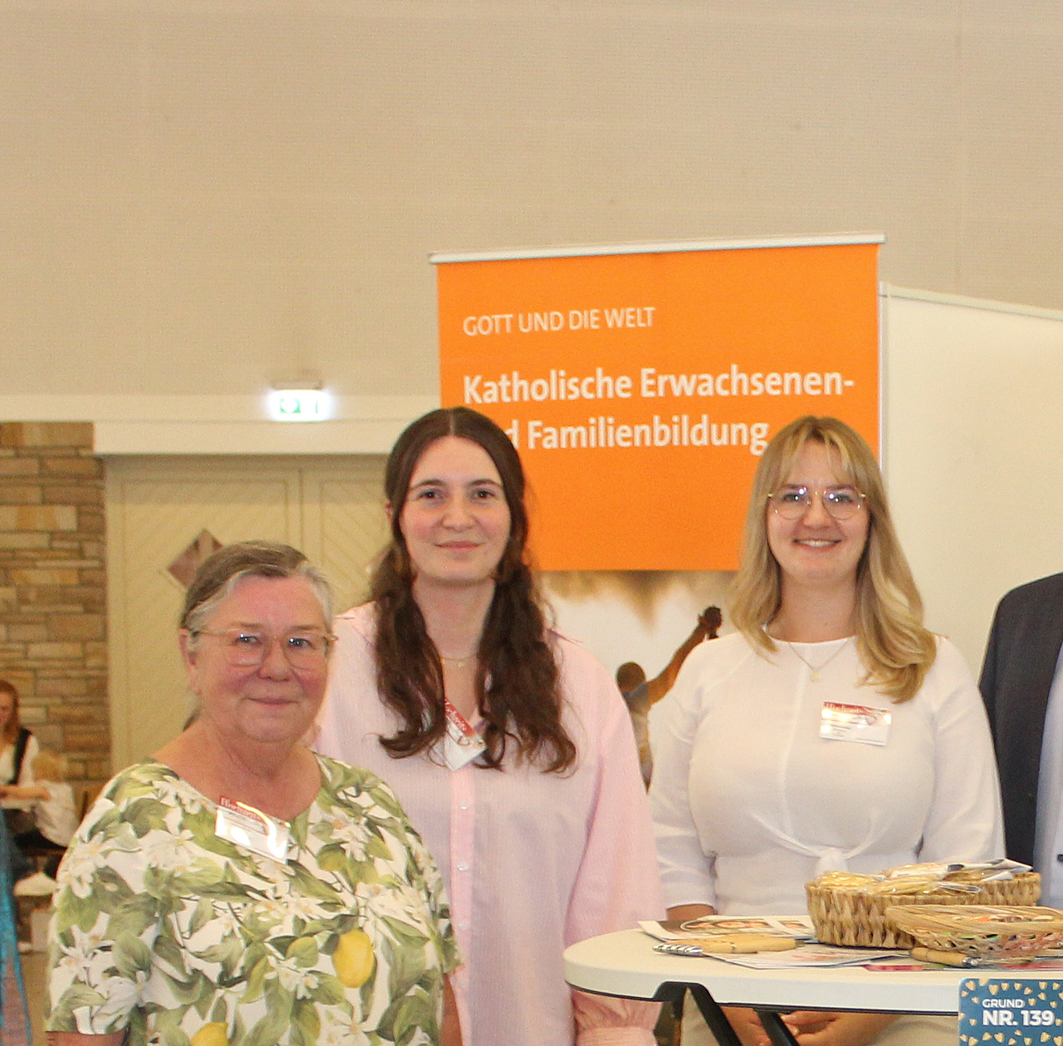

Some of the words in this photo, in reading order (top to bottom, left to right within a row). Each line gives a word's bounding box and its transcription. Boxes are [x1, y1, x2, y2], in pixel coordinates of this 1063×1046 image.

[463, 314, 513, 336] GOTT
[518, 311, 564, 333] UND
[569, 309, 600, 330] DIE
[604, 307, 656, 328] WELT
[463, 367, 633, 404] Katholische
[641, 363, 856, 398] Erwachsenen-
[528, 413, 770, 457] Familienbildung
[982, 999, 1025, 1009] GRUND
[982, 1010, 1019, 1026] NR.
[1020, 1010, 1056, 1026] 139
